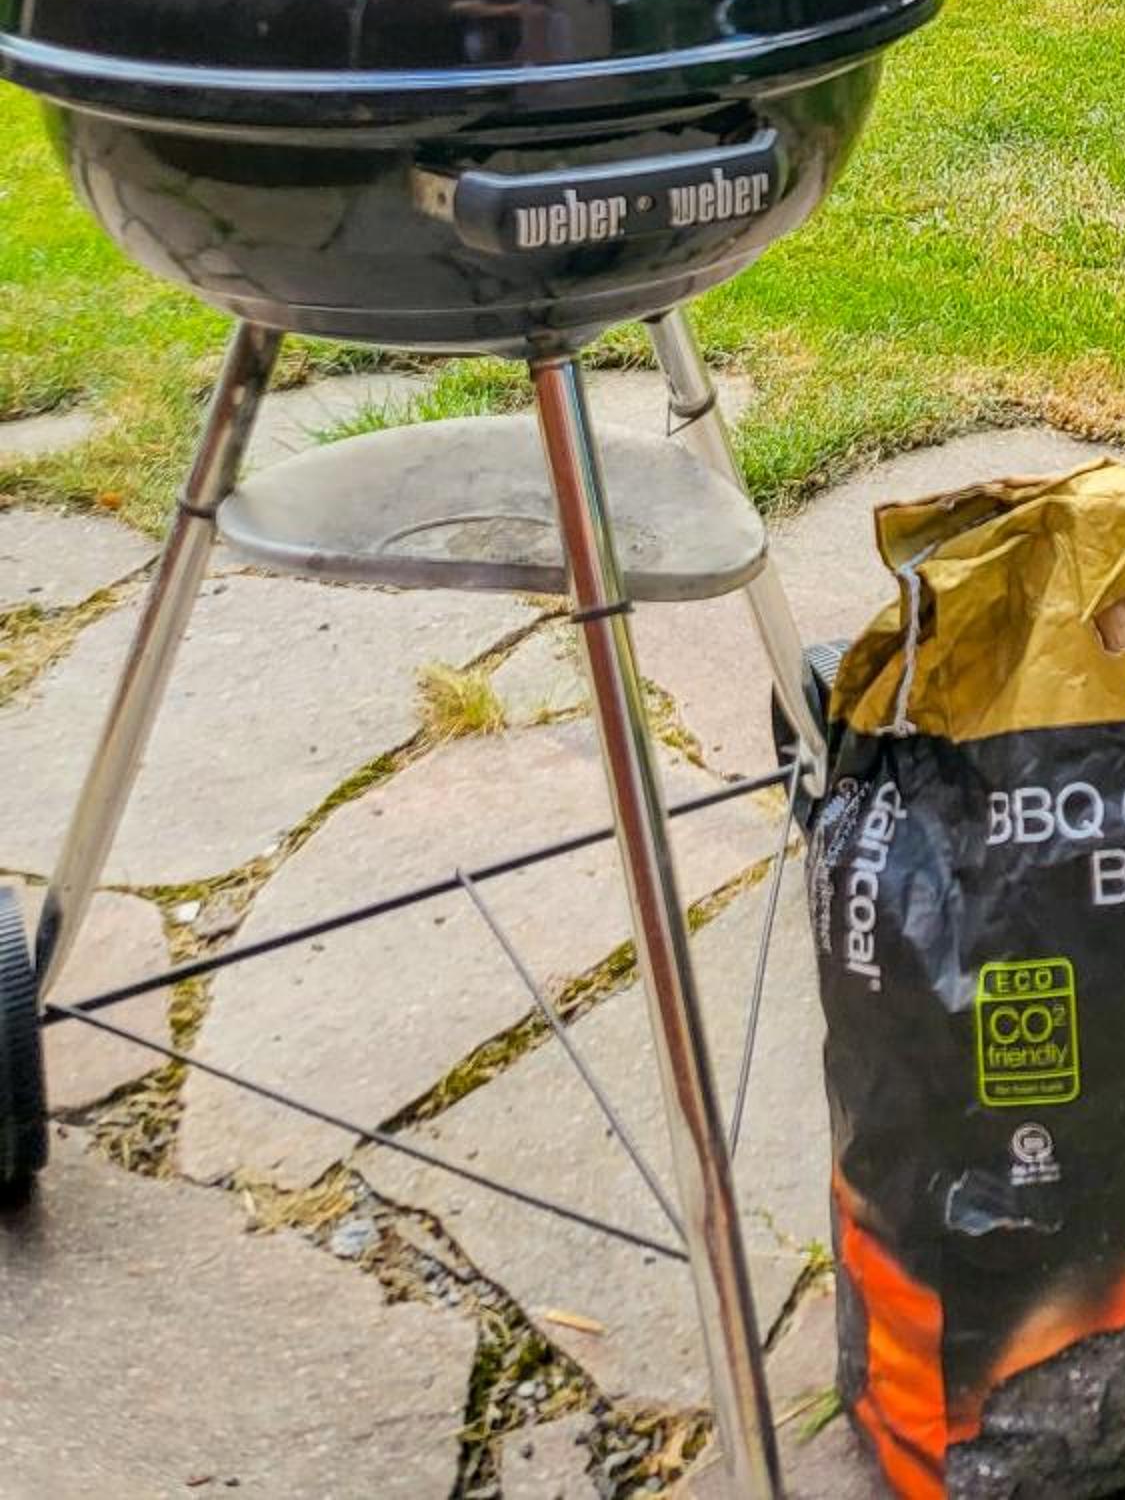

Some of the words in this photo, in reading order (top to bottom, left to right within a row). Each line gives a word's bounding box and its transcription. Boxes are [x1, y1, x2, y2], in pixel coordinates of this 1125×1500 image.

[986, 781, 1104, 845] BBQ
[995, 967, 1053, 993] ECO
[989, 1044, 1067, 1070] friendly
